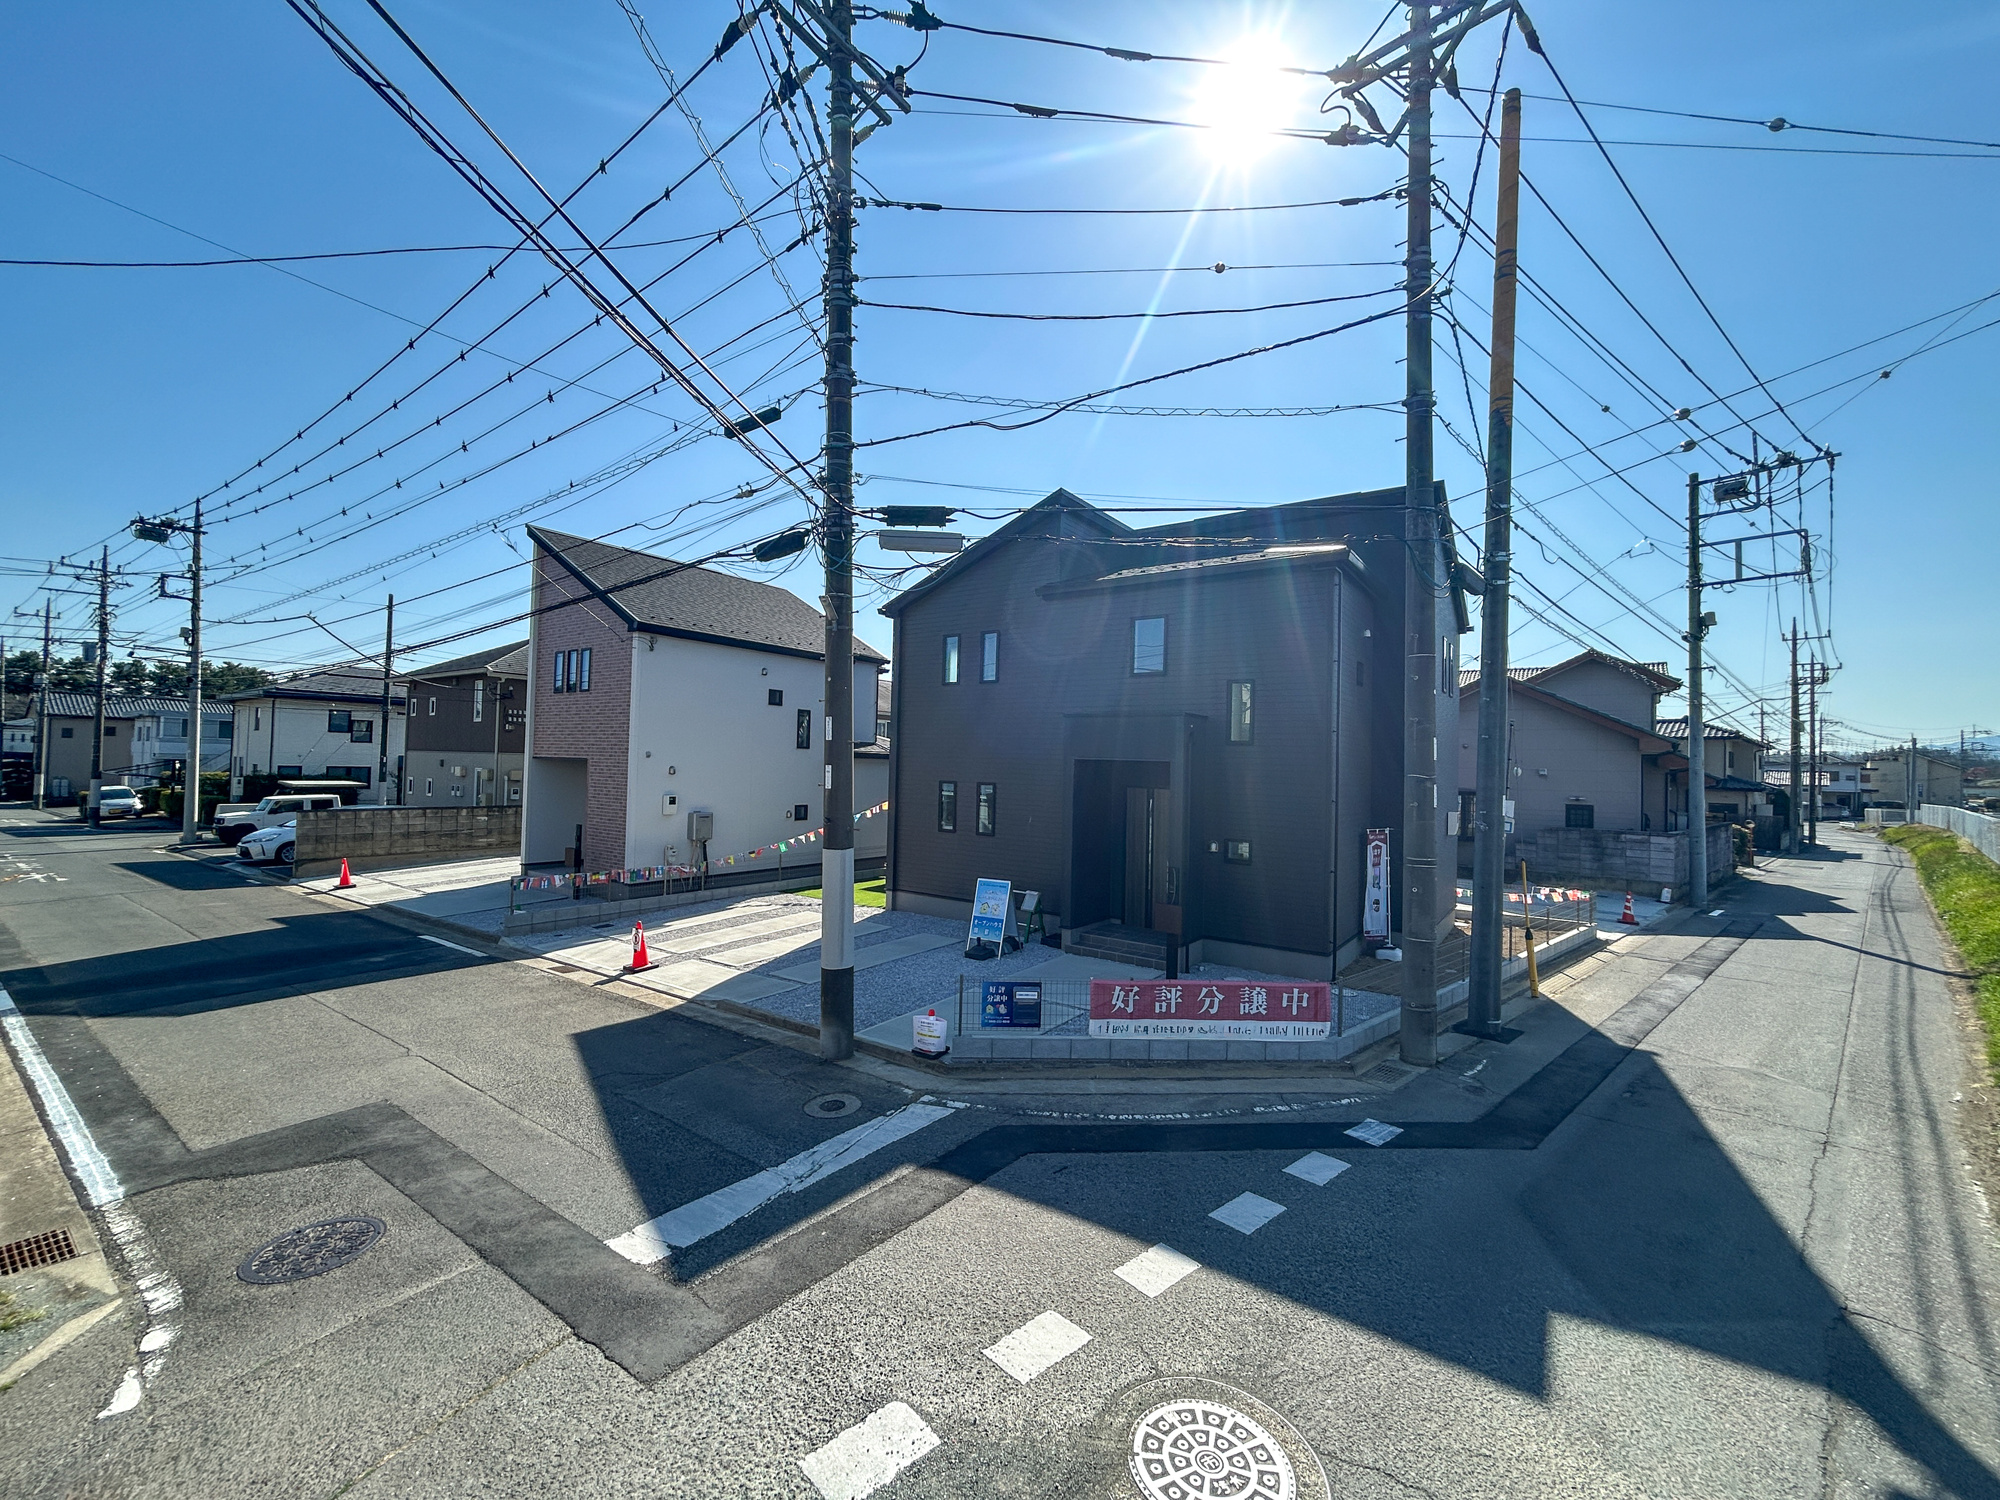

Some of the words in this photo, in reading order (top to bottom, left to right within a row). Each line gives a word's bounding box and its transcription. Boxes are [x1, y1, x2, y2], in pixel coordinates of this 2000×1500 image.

[1111, 985, 1310, 1016] 好評分譲中
